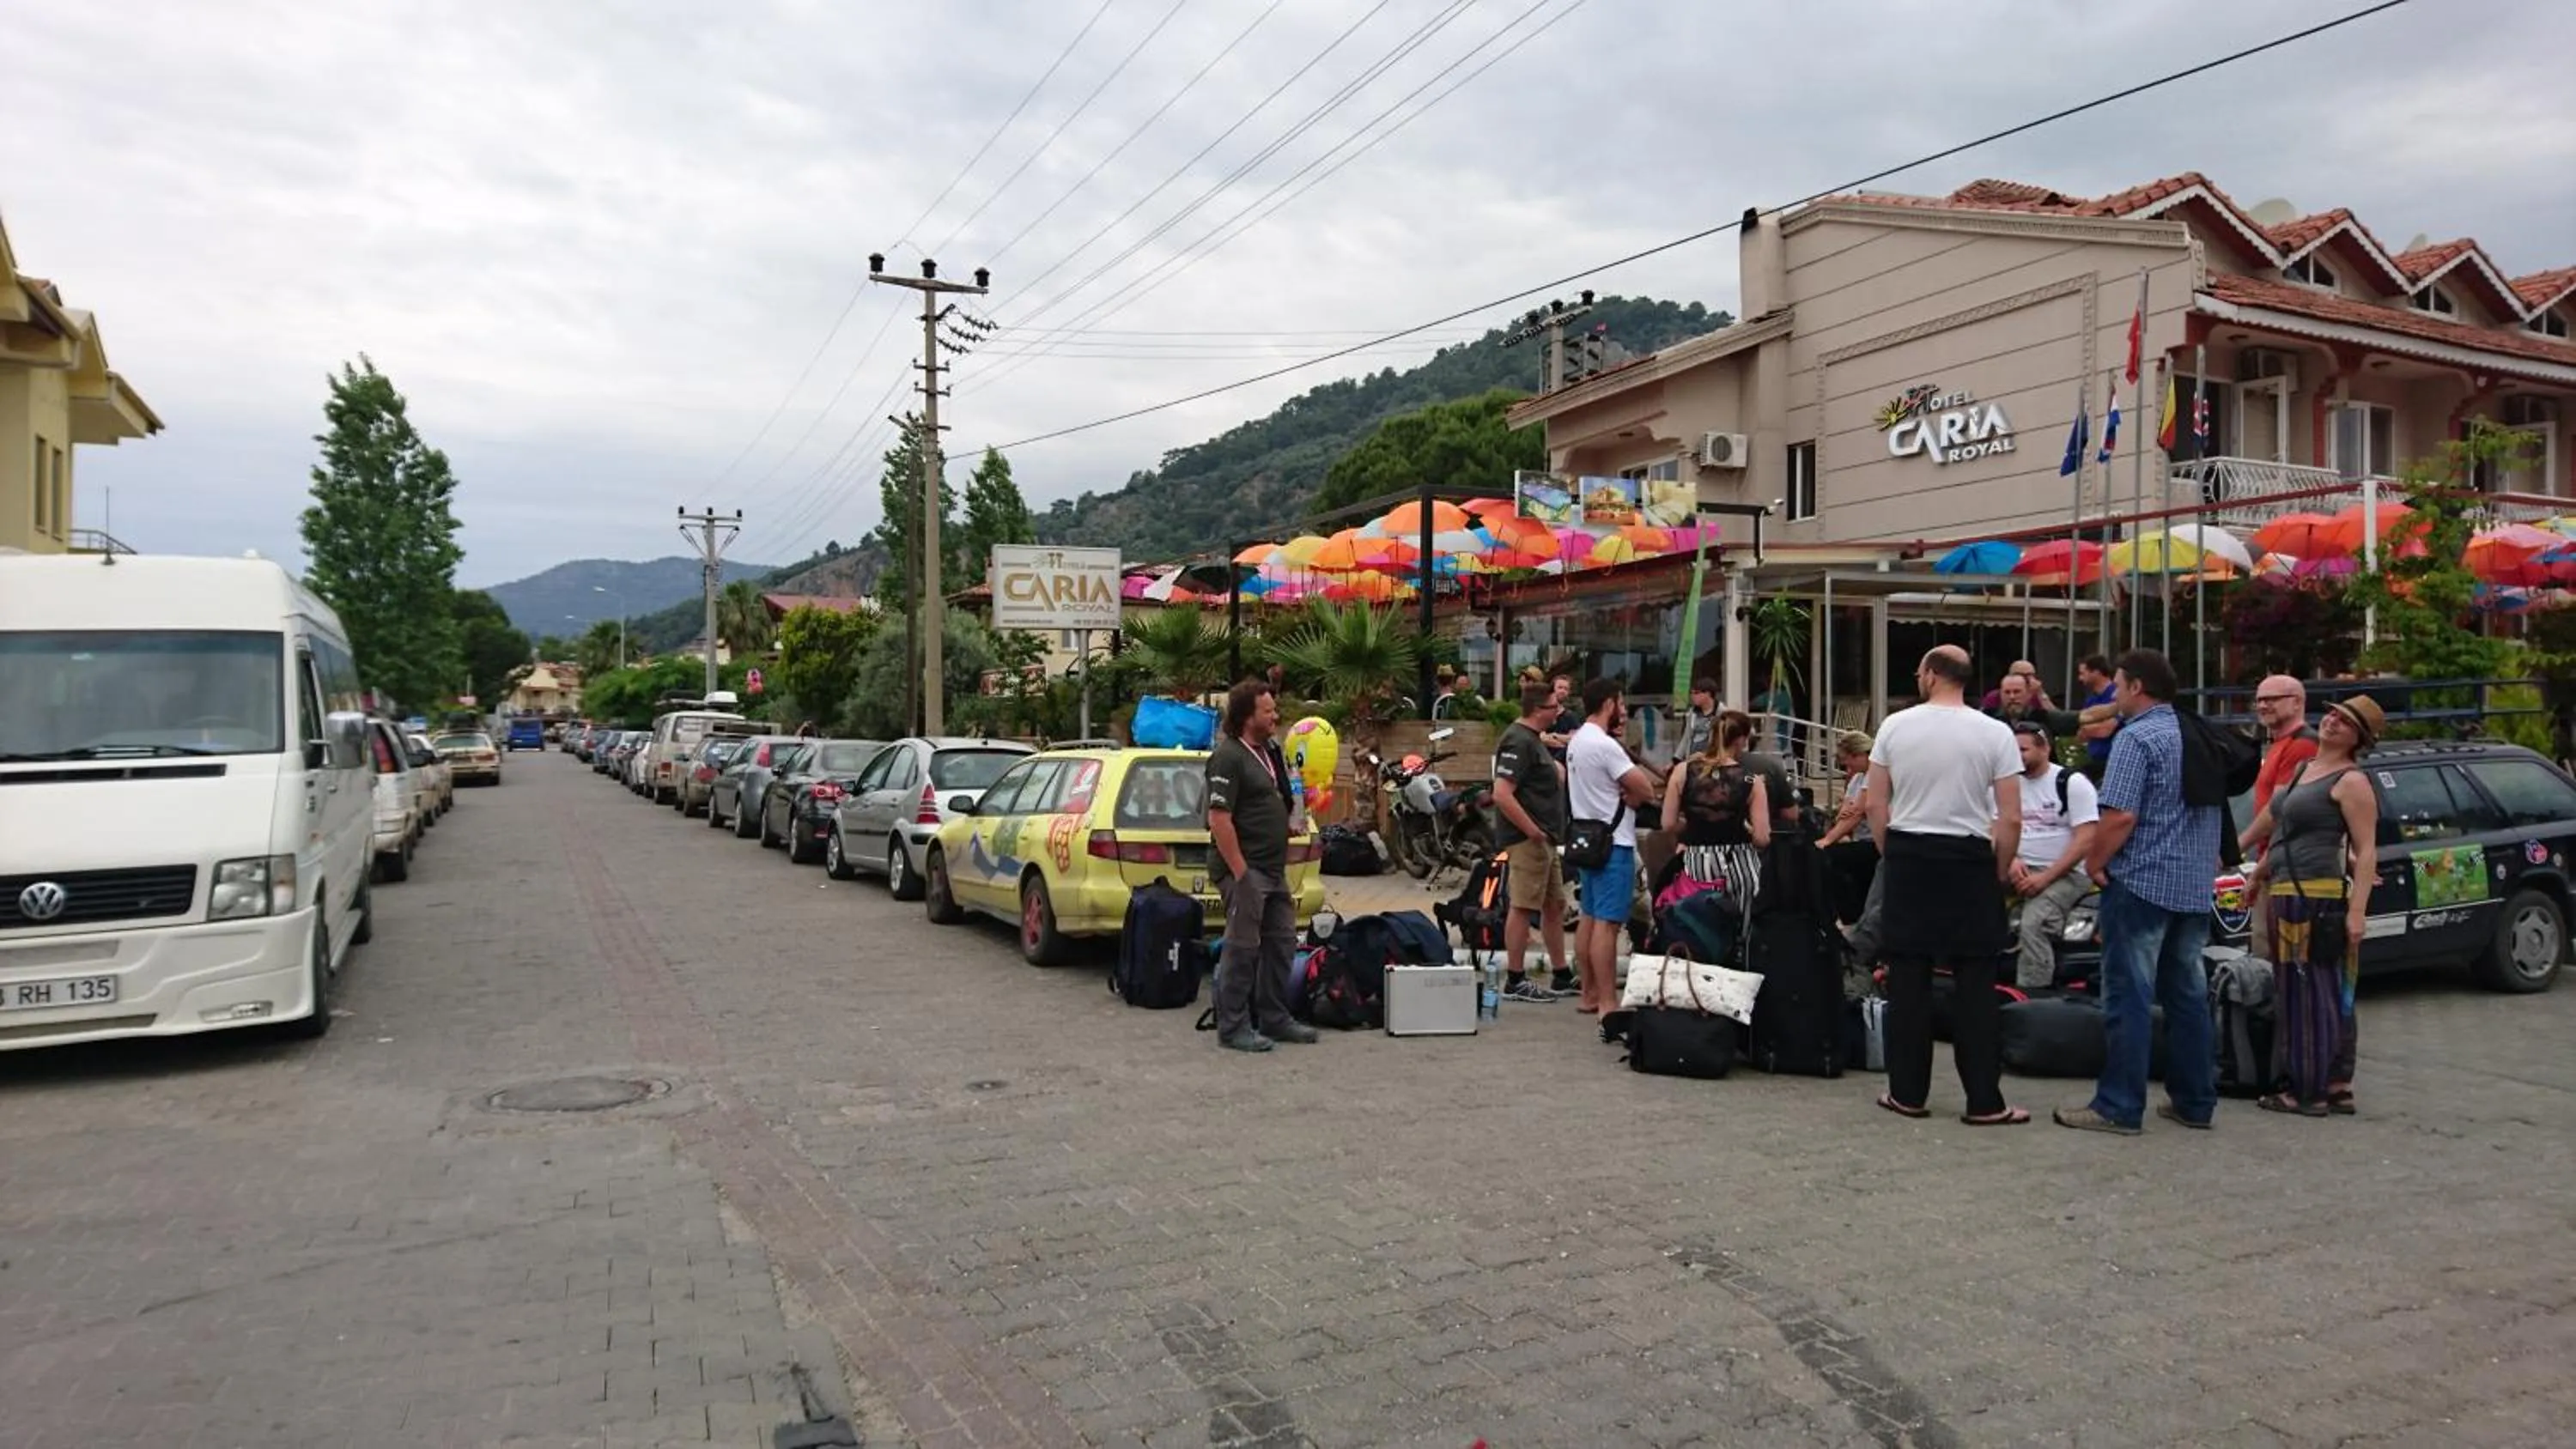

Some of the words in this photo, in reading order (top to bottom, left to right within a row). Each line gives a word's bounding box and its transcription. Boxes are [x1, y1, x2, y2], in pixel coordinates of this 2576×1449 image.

[1889, 403, 2012, 464] CARIA
[1948, 440, 2016, 463] ROYAL
[1004, 573, 1113, 612] CARIA
[1061, 603, 1114, 613] ROYAL
[19, 985, 51, 1004] RH
[67, 978, 111, 1000] 135
